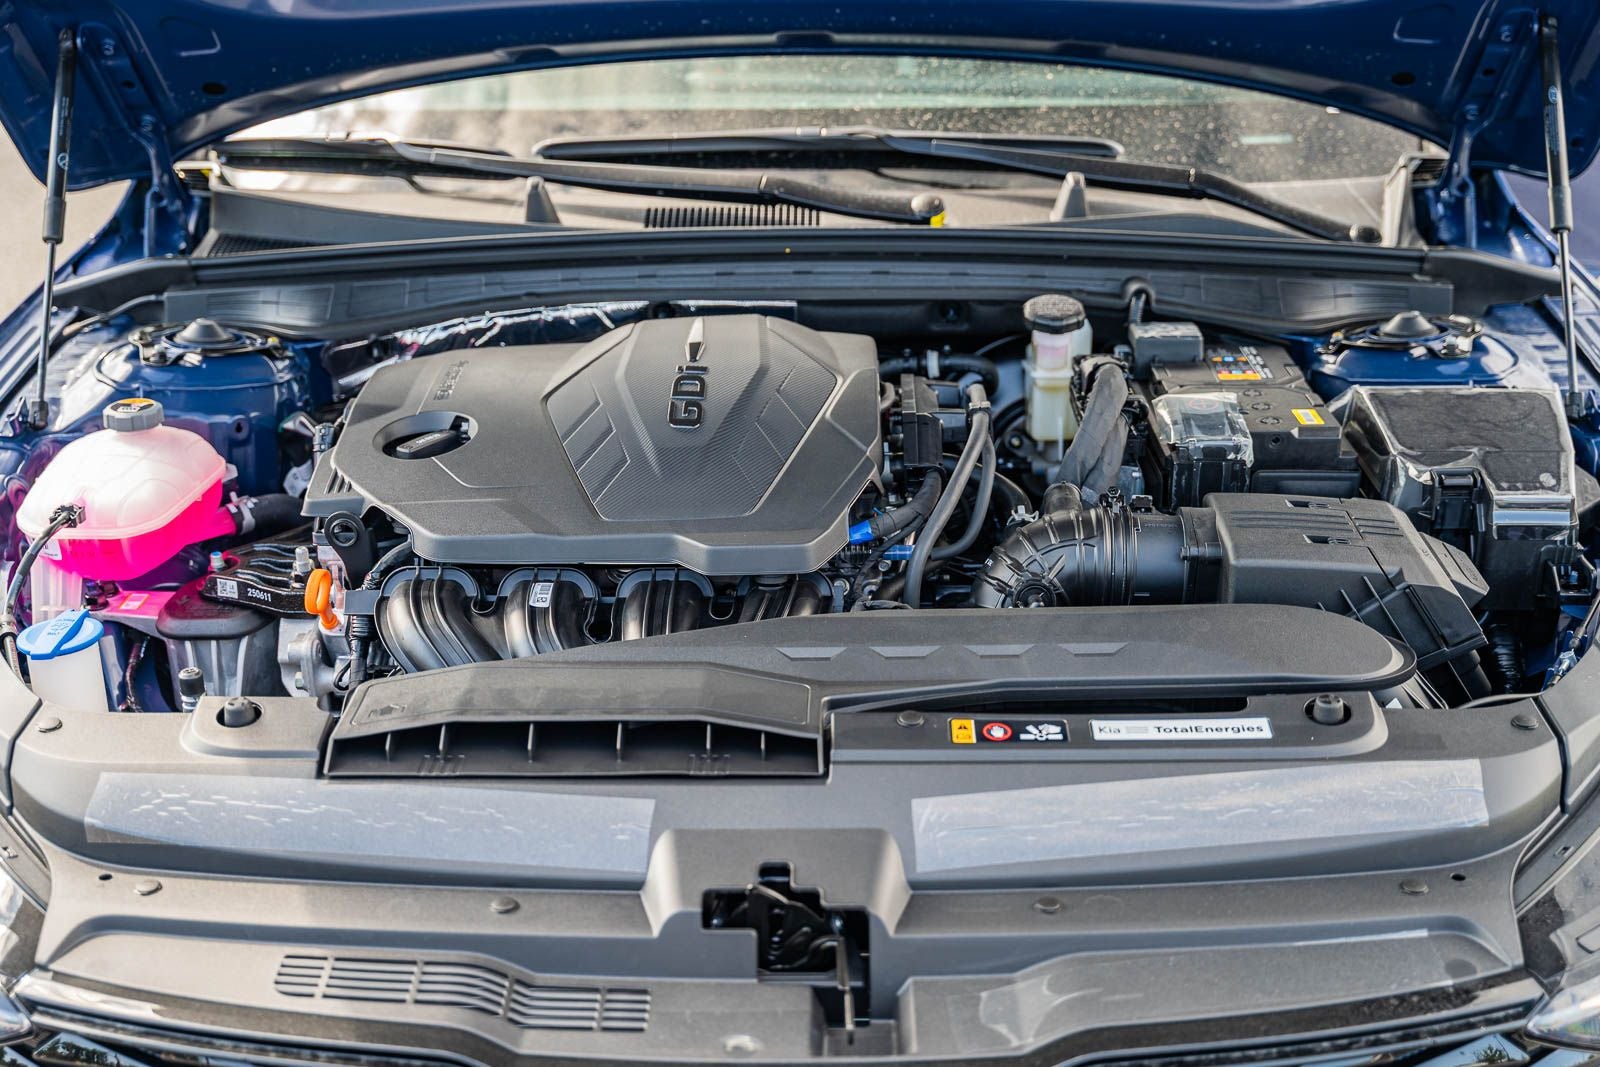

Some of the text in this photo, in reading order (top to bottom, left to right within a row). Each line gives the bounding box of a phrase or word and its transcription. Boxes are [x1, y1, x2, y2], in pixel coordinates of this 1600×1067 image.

[667, 365, 708, 429] GDi
[247, 588, 272, 602] 250611
[1098, 724, 1264, 736] Kia TotalEnergies
